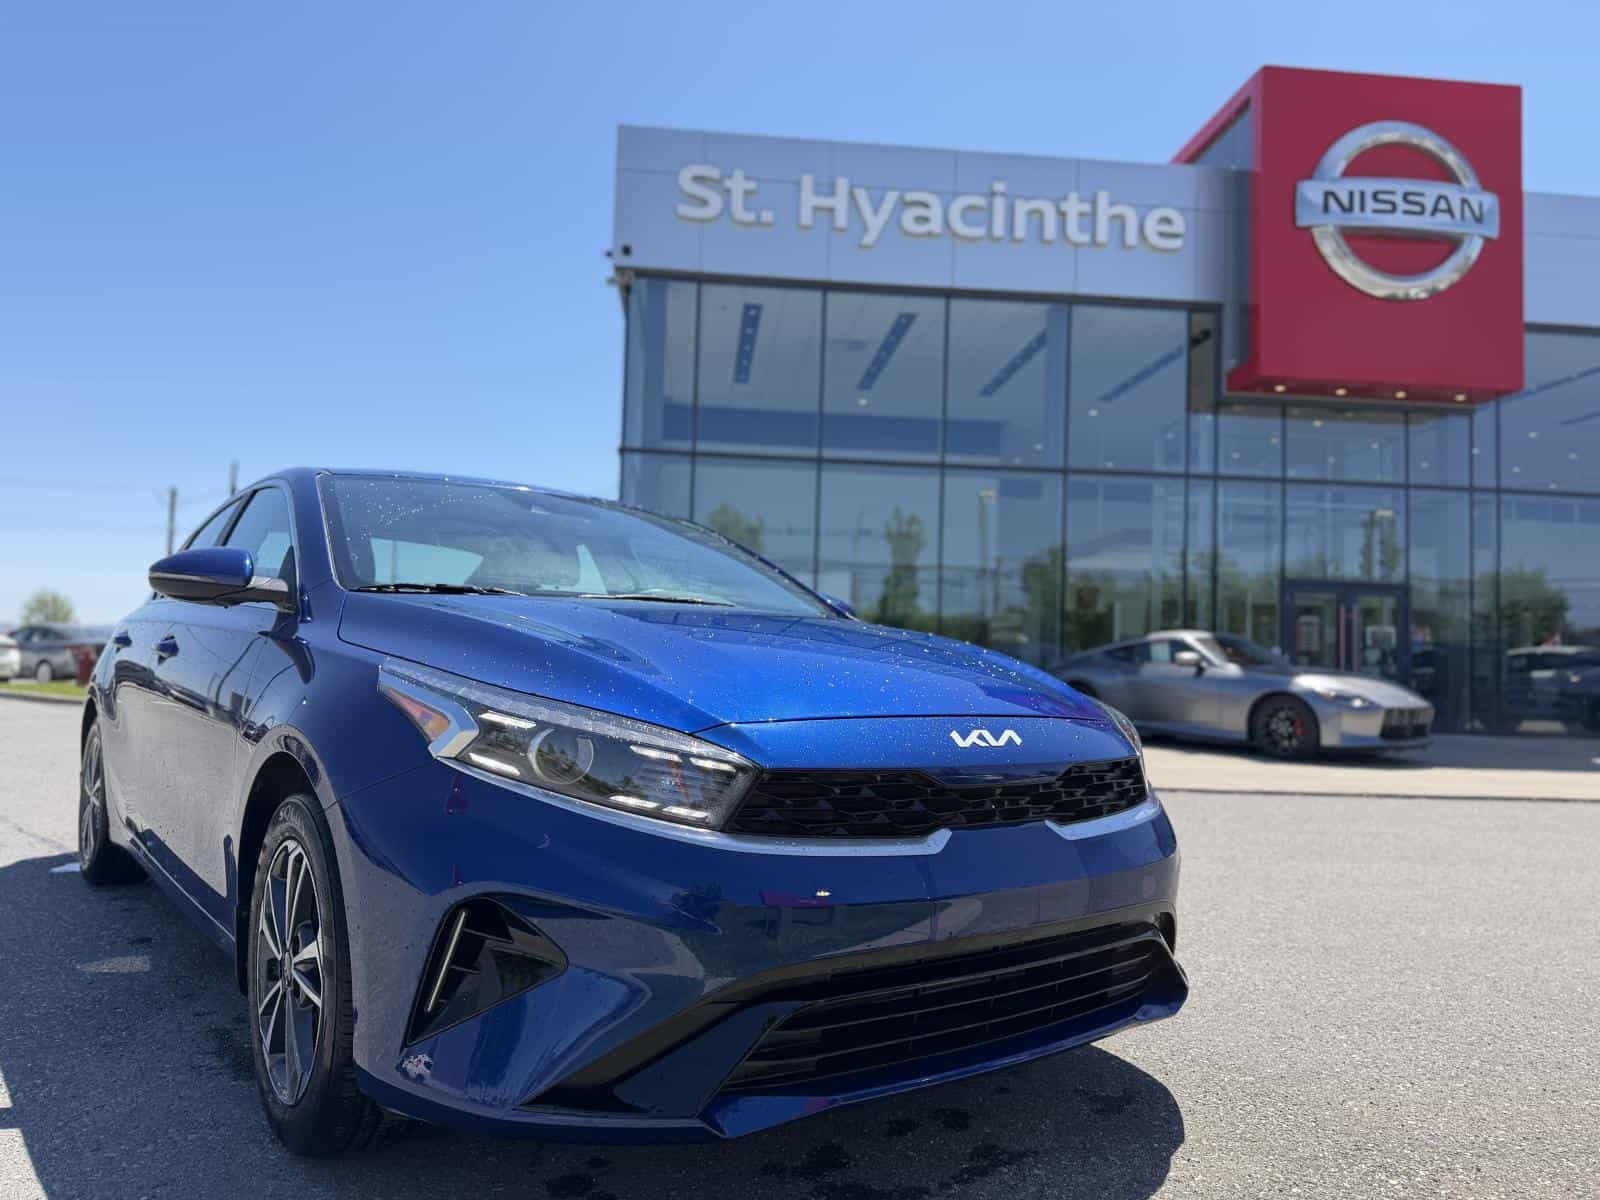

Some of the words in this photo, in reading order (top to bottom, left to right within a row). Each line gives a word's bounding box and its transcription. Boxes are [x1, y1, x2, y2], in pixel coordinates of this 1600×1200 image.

[676, 164, 775, 225] St.
[798, 174, 1187, 250] Hyacinthe
[1322, 189, 1485, 224] NISSAN
[950, 729, 1023, 748] KIA
